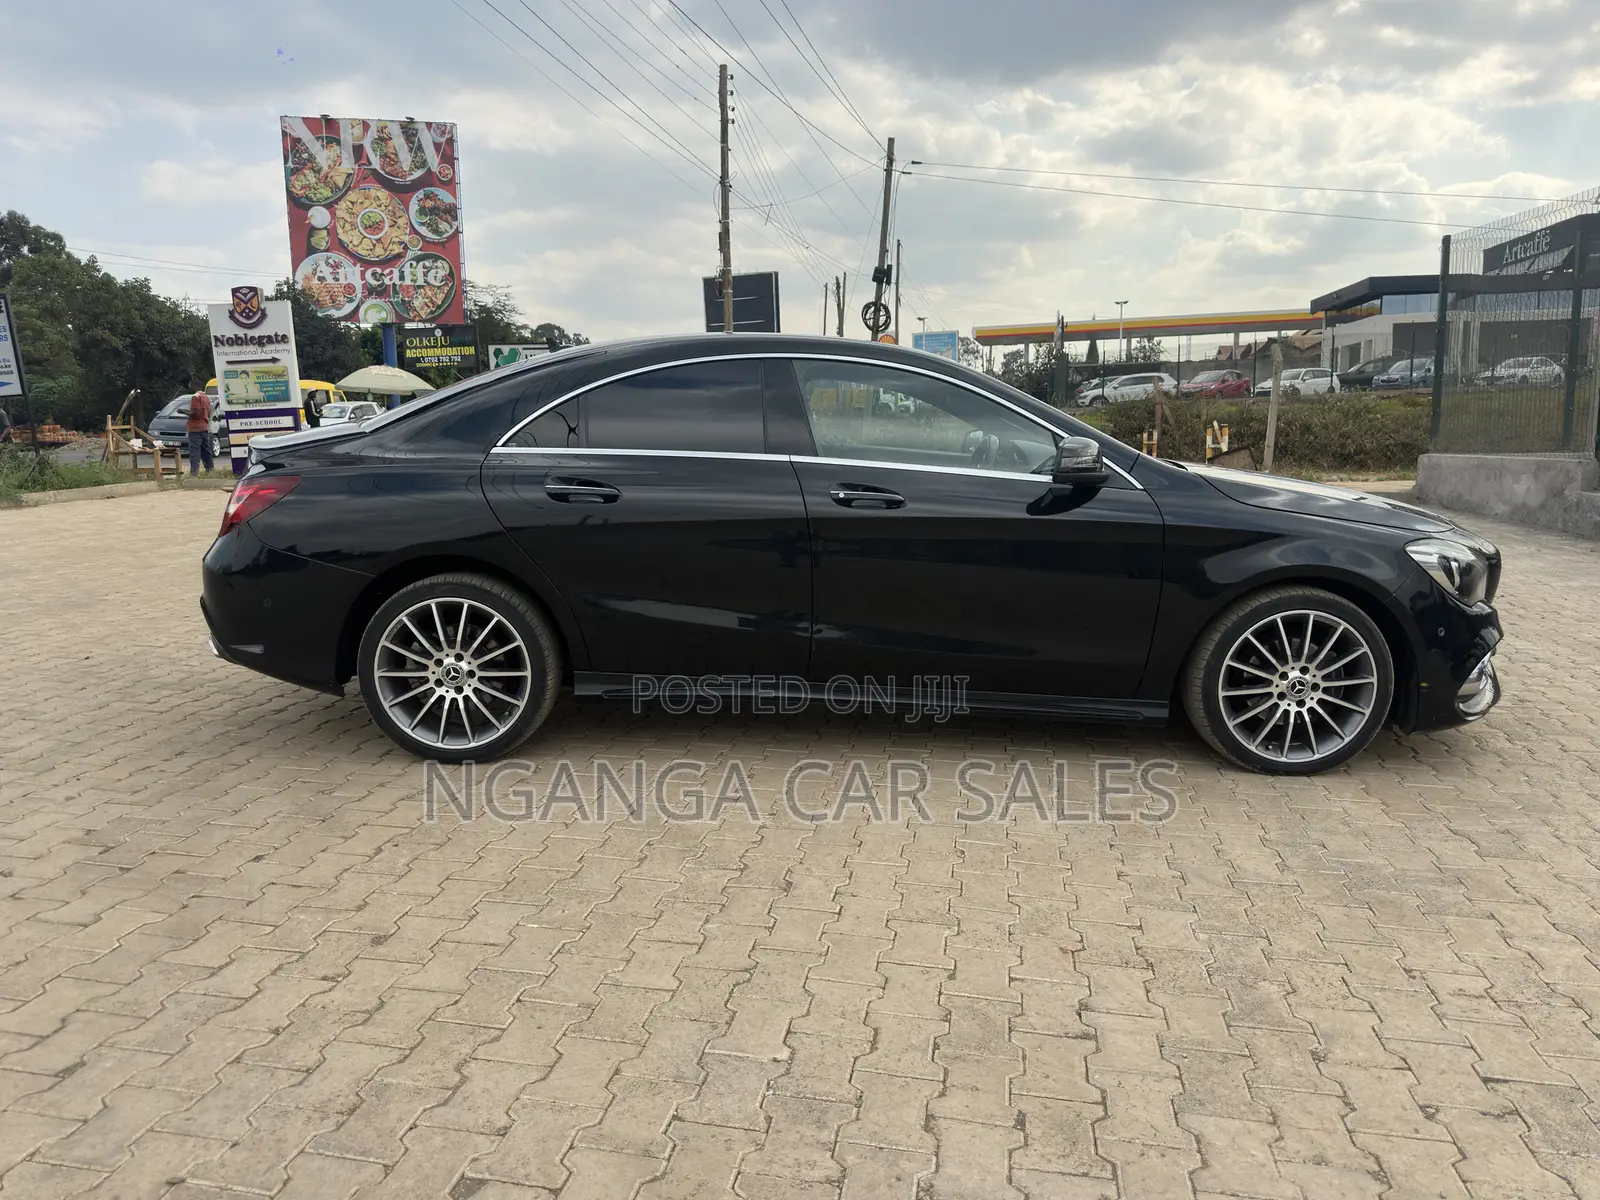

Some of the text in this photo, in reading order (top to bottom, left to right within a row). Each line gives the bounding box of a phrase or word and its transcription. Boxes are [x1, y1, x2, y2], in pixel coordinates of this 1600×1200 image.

[282, 117, 452, 172] NEW
[212, 331, 290, 347] Noblegate
[406, 335, 450, 347] OLKEJU
[216, 347, 291, 357] International Academy
[405, 346, 476, 358] ACCOMMODATION
[240, 419, 283, 427] PRE-SCHOOL
